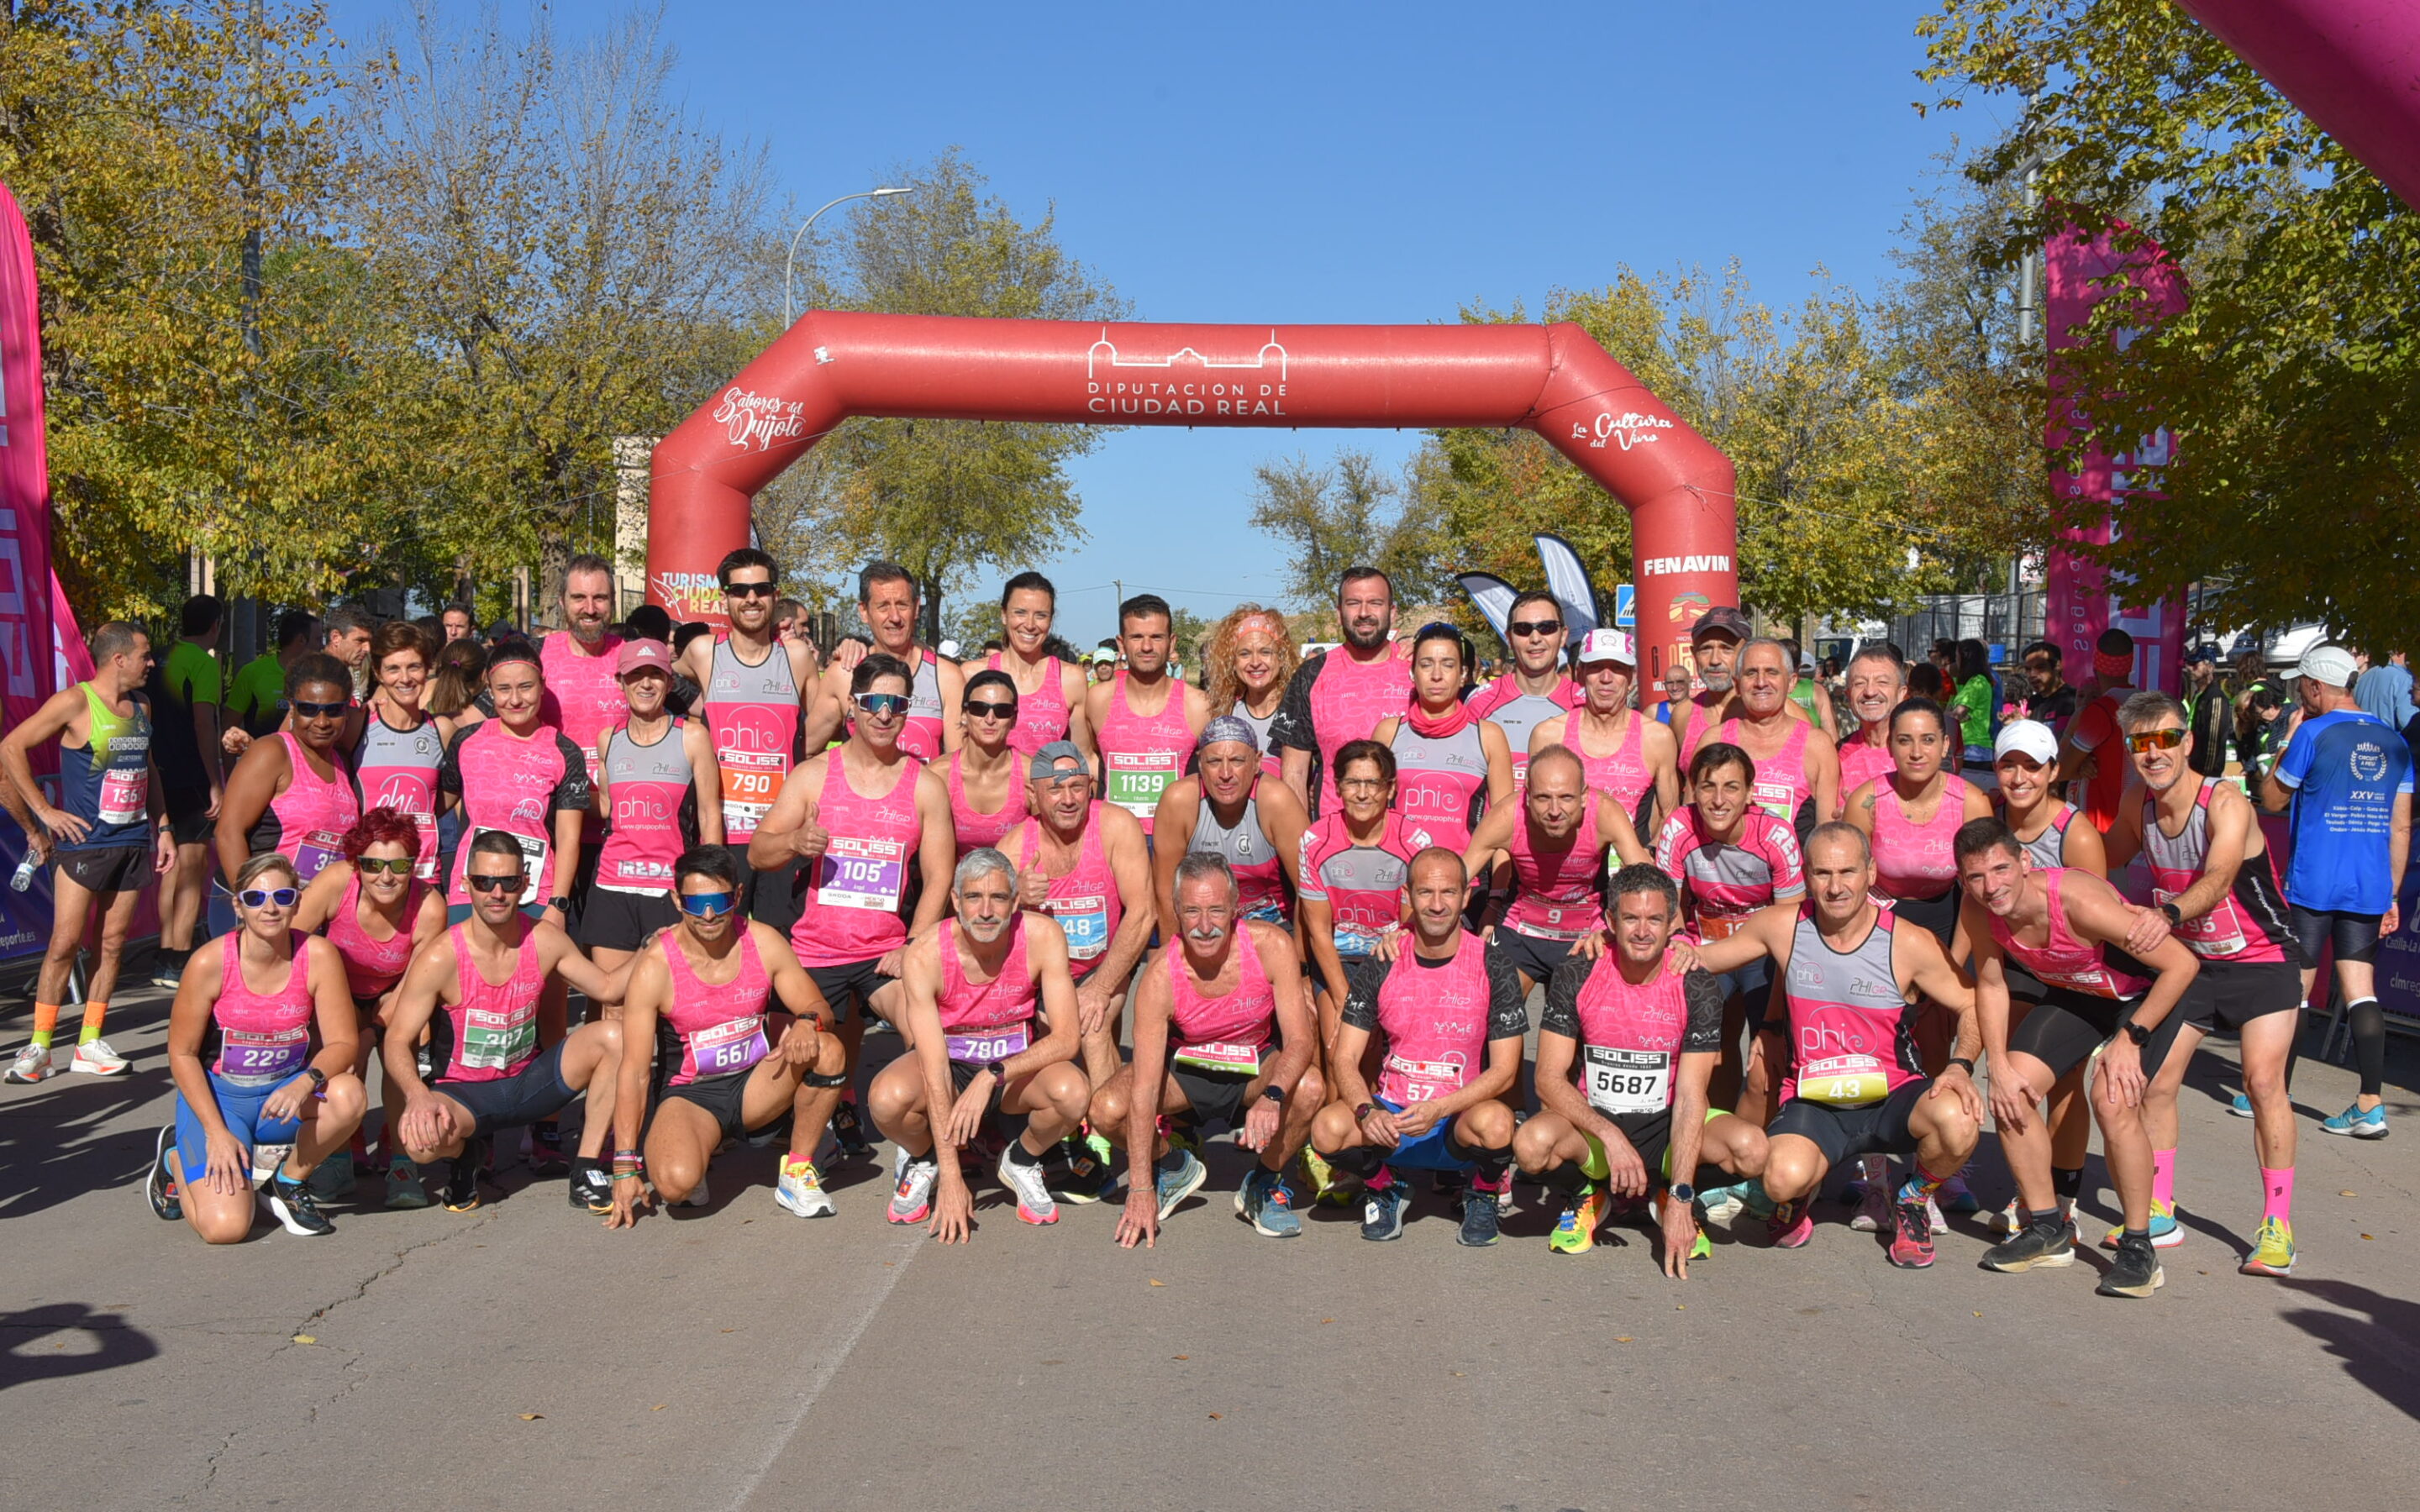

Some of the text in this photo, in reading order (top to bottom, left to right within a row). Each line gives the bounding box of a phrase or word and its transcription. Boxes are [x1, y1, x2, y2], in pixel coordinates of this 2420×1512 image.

[1088, 382, 1286, 396] DIPUTACIÓN DE
[713, 386, 804, 423] Sabores del
[1088, 397, 1286, 415] CIUDAD REAL
[728, 408, 806, 451] Quijote
[1571, 412, 1674, 438] La Cultura
[1590, 429, 1660, 450] del Vino
[1644, 555, 1730, 576] FENAVIN
[661, 572, 721, 589] TURISM
[672, 585, 723, 601] CIUDA
[725, 753, 781, 766] SOLISS
[1113, 755, 1172, 765] SOLISS
[732, 773, 771, 794] 790
[1121, 774, 1164, 793] 1139
[2350, 790, 2374, 801] XXV
[832, 838, 897, 856] SOLISS
[843, 860, 881, 882] 105
[1045, 899, 1098, 911] OLISS
[1547, 909, 1562, 924] 9
[232, 1028, 303, 1042] SOLISS
[696, 1019, 759, 1043] SOLISS
[242, 1049, 290, 1067] 229
[715, 1040, 751, 1068] 667
[965, 1039, 1007, 1059] 780
[1592, 1047, 1663, 1064] SOLISS
[1390, 1057, 1455, 1078] SOLISS
[1807, 1056, 1879, 1074] SOLISS
[1406, 1083, 1434, 1101] 57
[1597, 1071, 1657, 1095] 5687
[1828, 1079, 1861, 1100] 43
